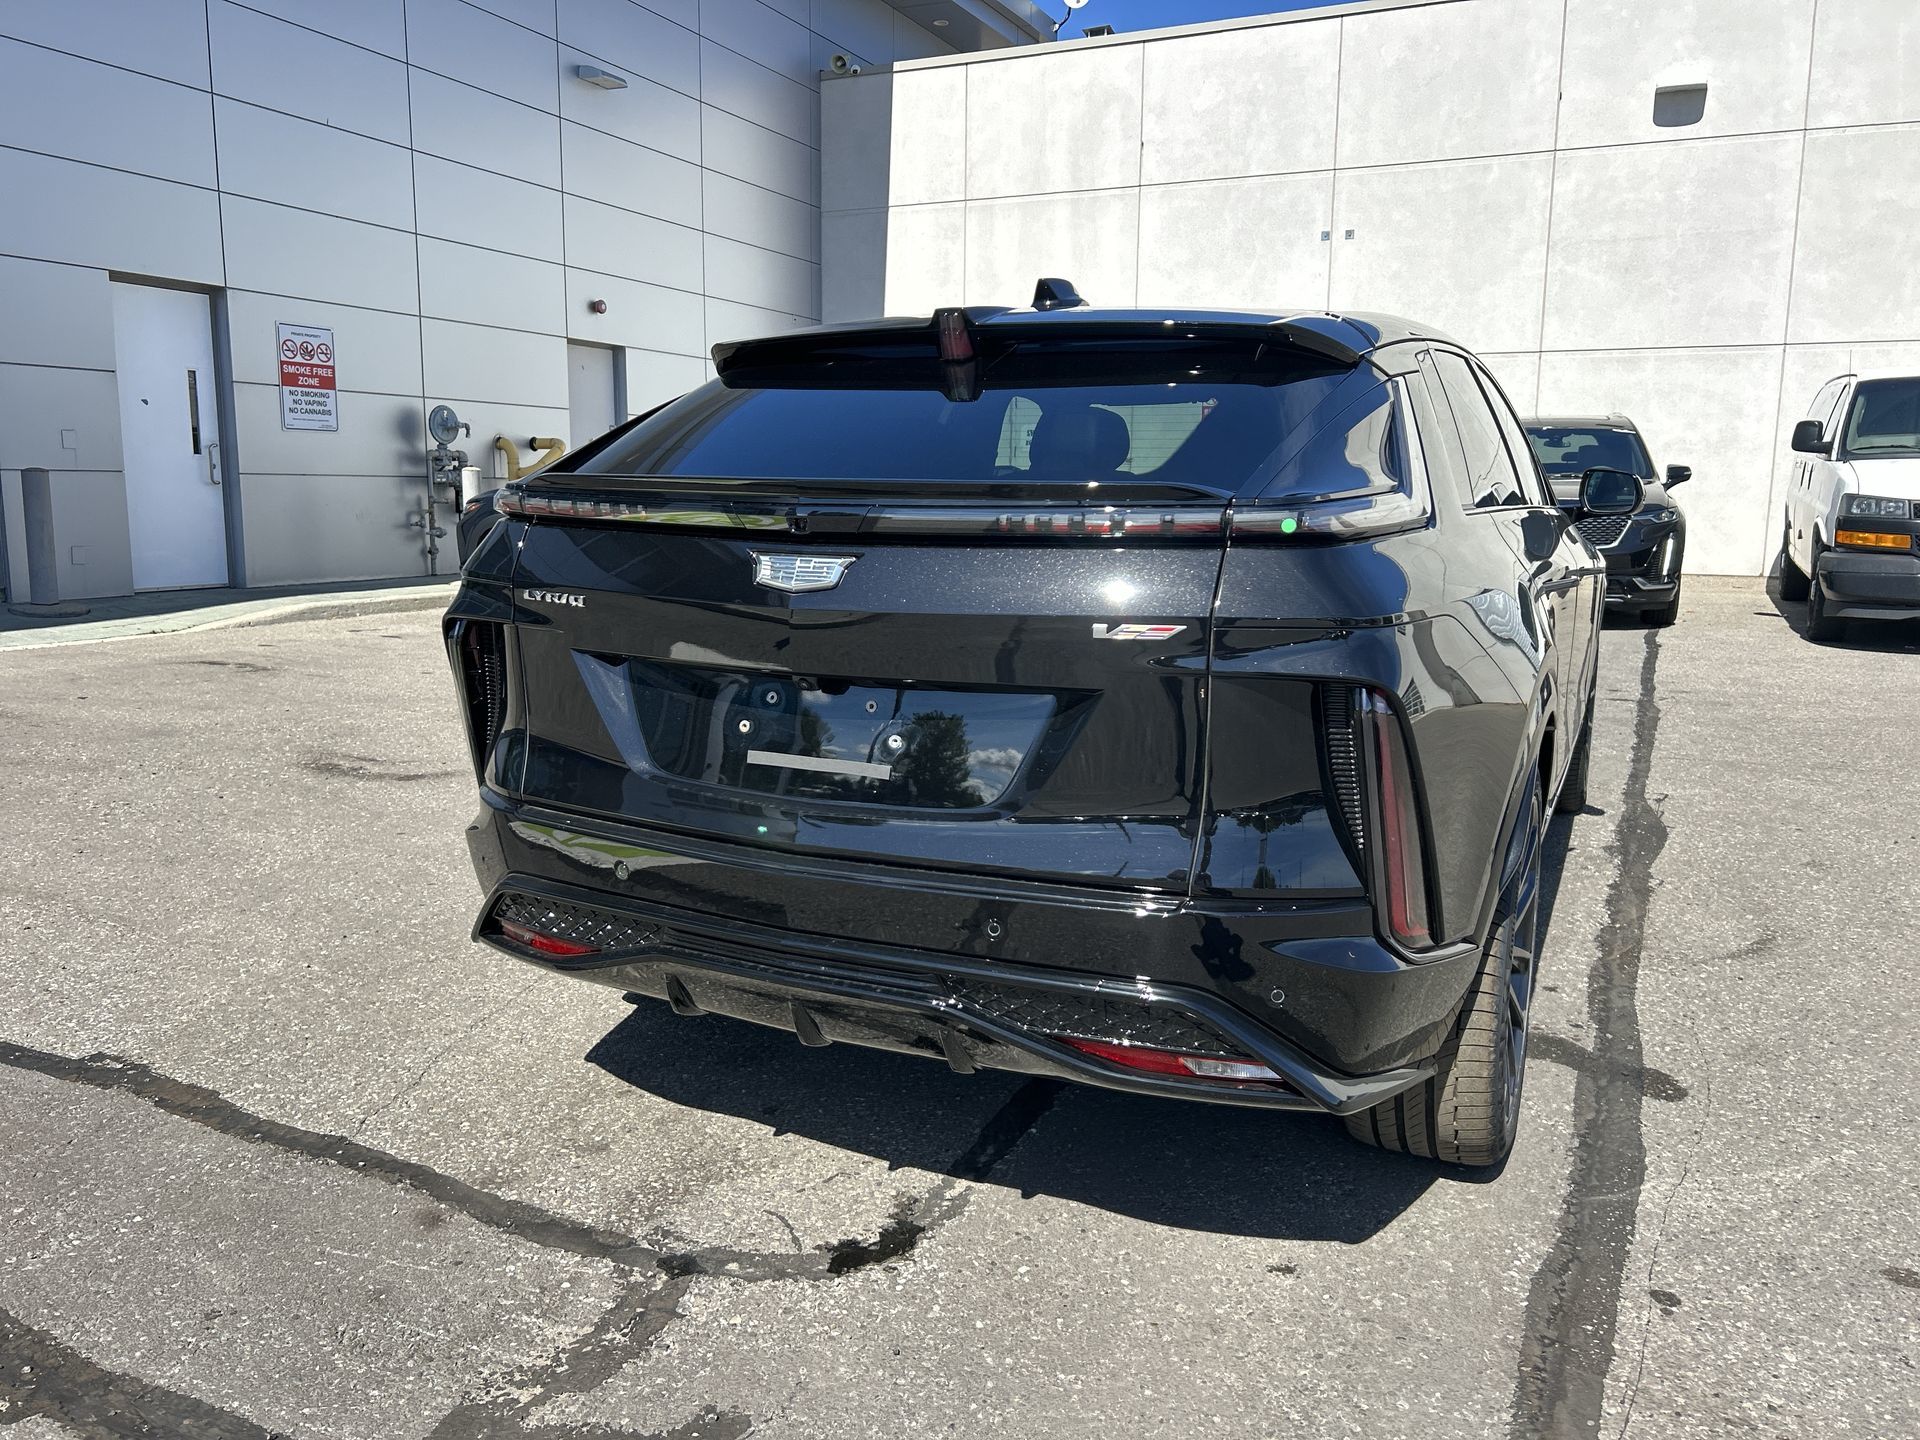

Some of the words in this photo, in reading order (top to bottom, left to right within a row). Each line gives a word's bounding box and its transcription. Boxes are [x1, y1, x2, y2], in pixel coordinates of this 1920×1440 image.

[282, 364, 311, 375] SMOKE
[313, 367, 333, 377] FREE
[298, 376, 320, 386] ZONE
[289, 389, 299, 397] NO
[300, 389, 330, 399] SMOKING
[292, 398, 303, 406] NO
[304, 399, 328, 408] VAPING
[300, 407, 332, 416] CANNABIS
[523, 589, 586, 607] LYRIQ
